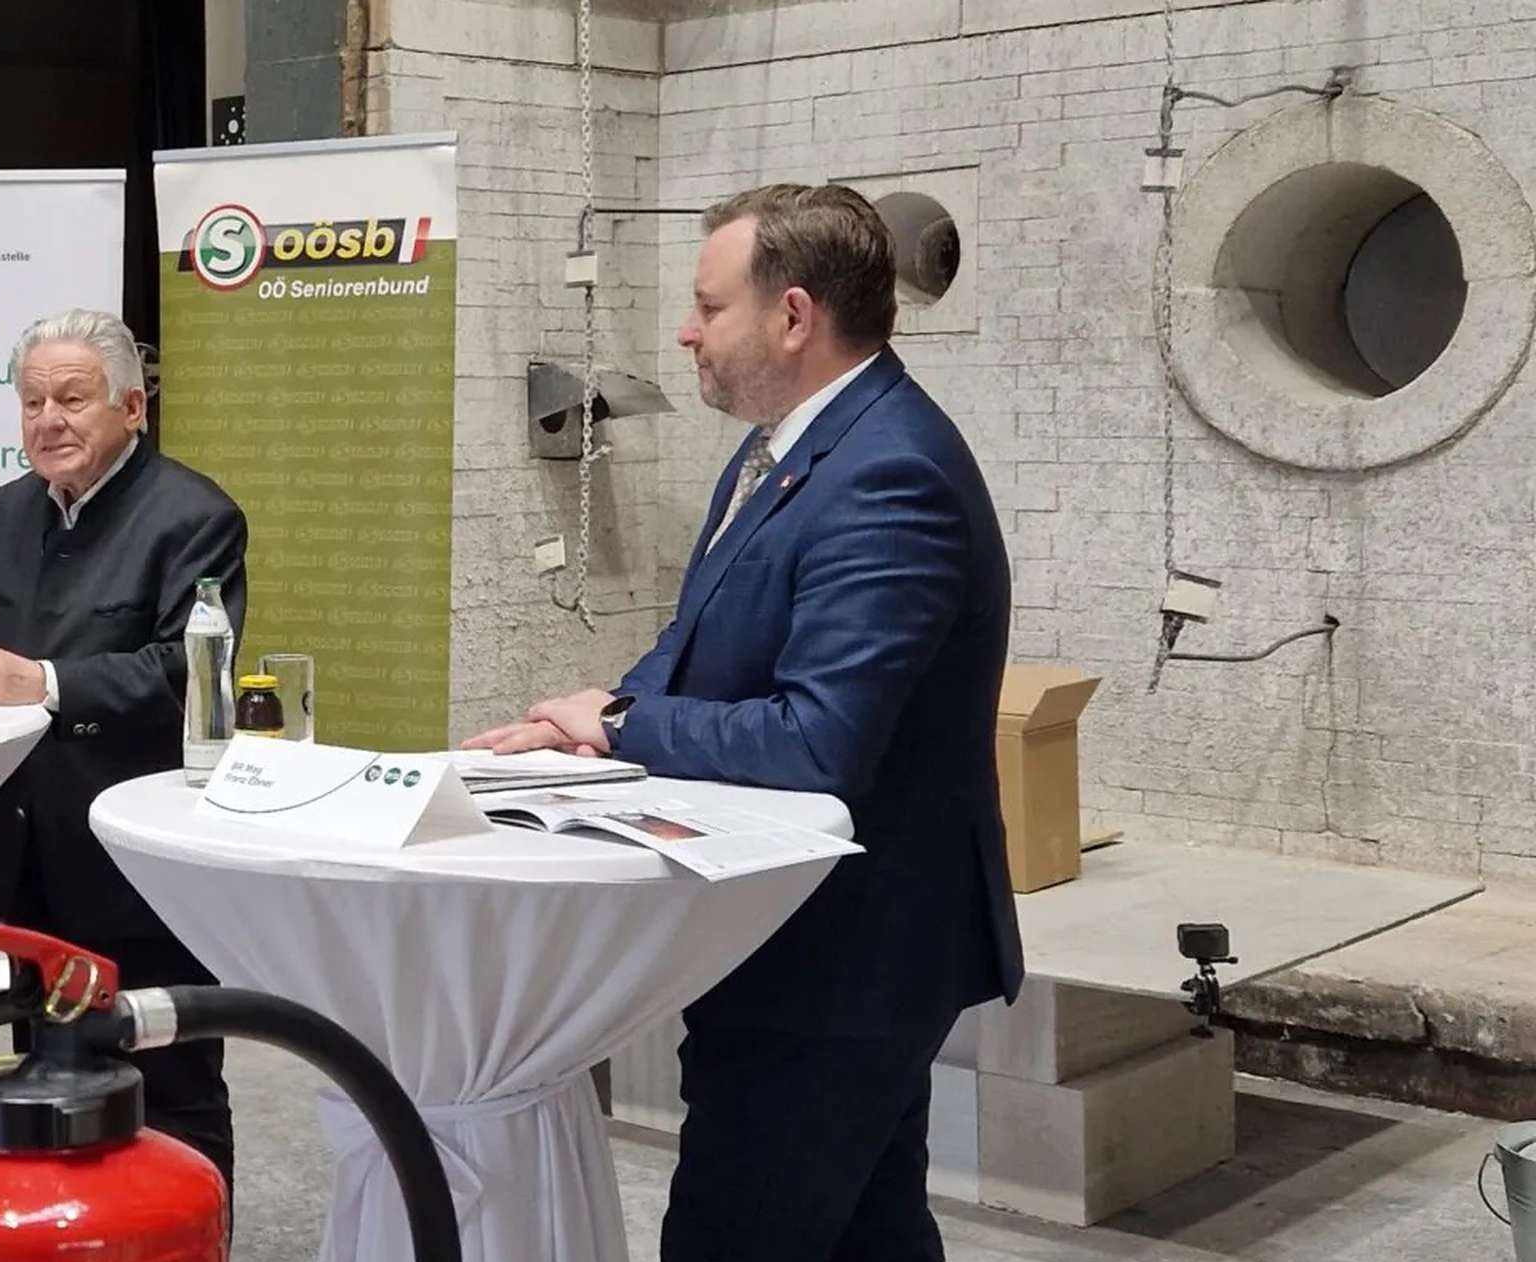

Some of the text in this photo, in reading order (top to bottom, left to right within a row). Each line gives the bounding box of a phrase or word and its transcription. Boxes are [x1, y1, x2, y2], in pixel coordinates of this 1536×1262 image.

[273, 218, 397, 262] oösb
[258, 275, 430, 299] OÖ Seniorenbund
